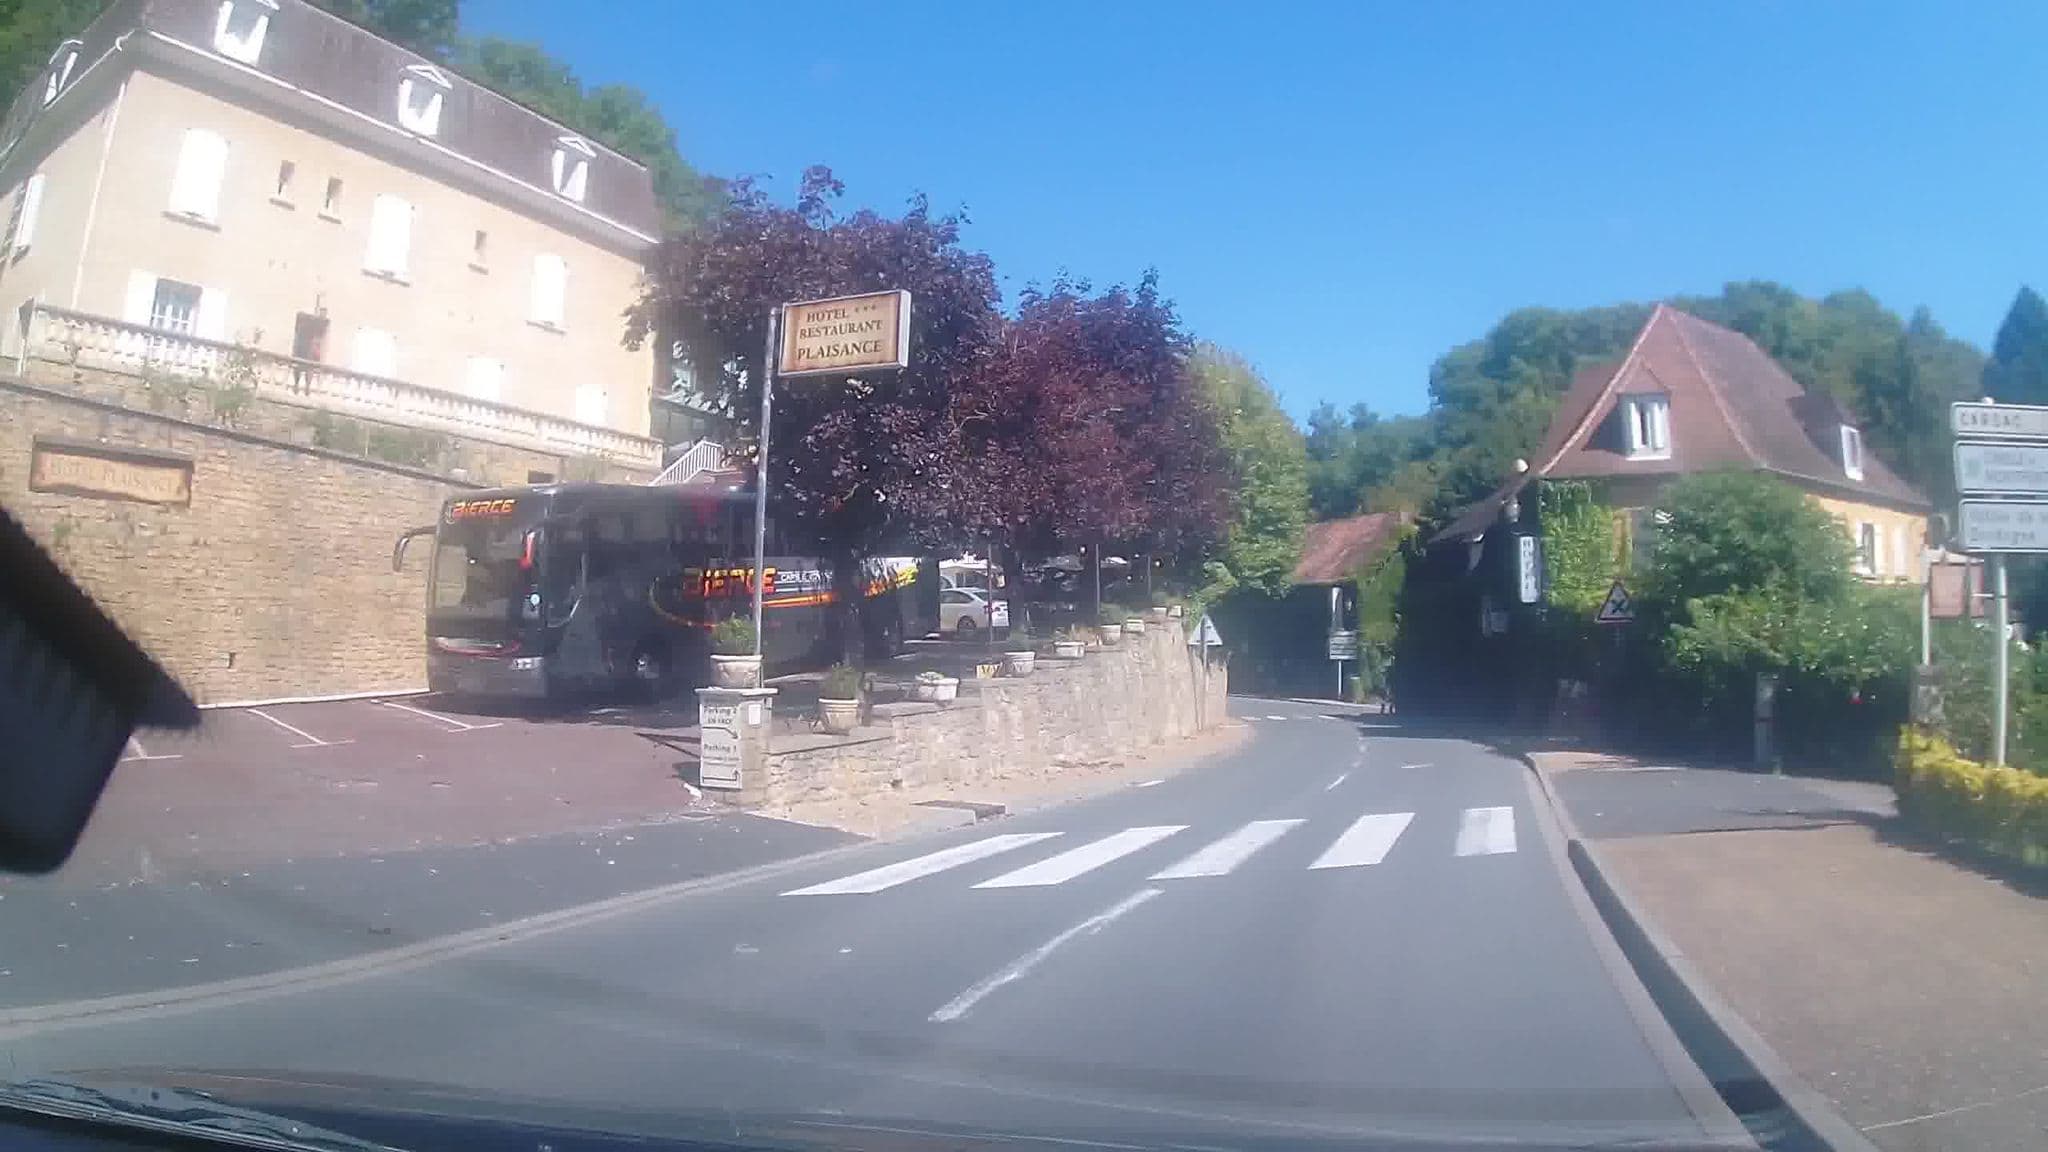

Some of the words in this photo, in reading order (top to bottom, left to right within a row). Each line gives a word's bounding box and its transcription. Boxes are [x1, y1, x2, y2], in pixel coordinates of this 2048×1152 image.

[806, 308, 850, 323] HOTEL
[799, 319, 884, 339] RESTAURANT
[797, 339, 884, 360] PLAISANCE
